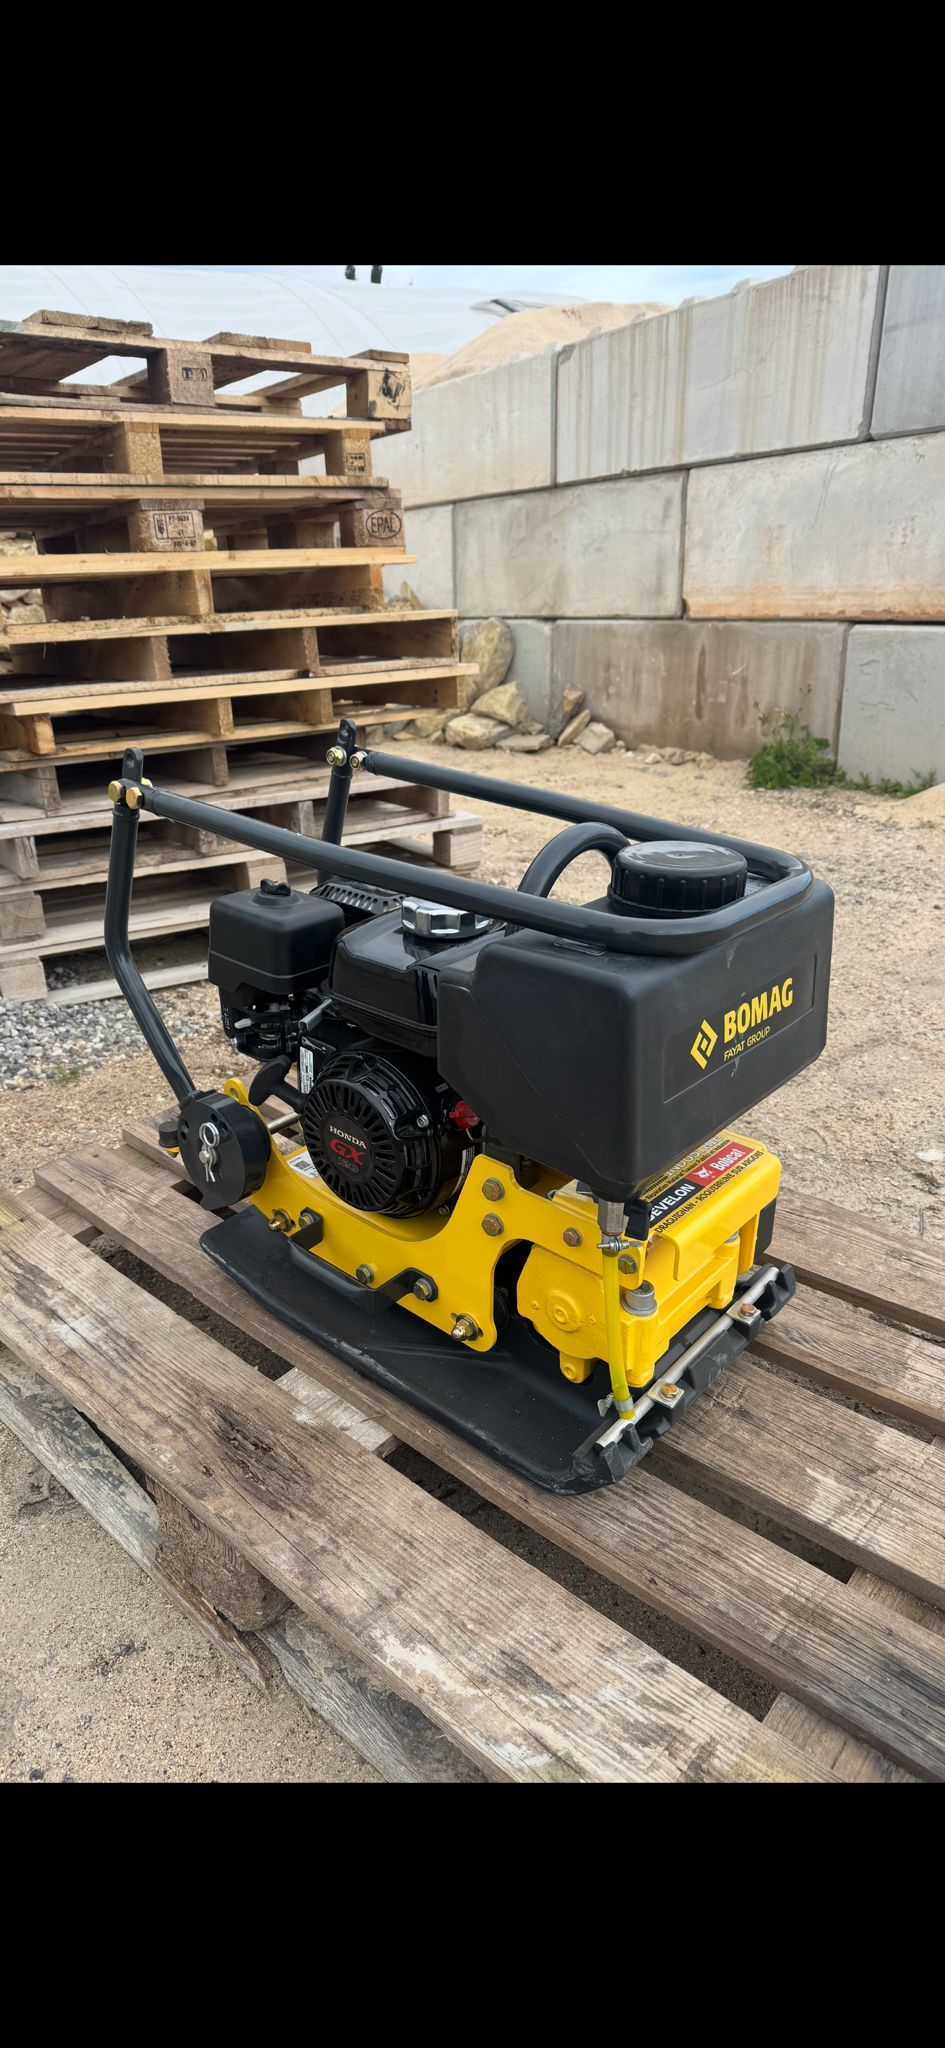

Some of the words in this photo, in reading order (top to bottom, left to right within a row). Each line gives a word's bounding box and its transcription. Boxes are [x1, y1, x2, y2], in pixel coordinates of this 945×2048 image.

[370, 516, 396, 533] EPAL
[723, 977, 793, 1044] BOMAG
[723, 1041, 745, 1062] FAYAT
[746, 1026, 771, 1047] GROUP
[329, 1125, 367, 1149] HONDA
[330, 1138, 364, 1167] GX
[709, 1148, 746, 1171] Bobcat
